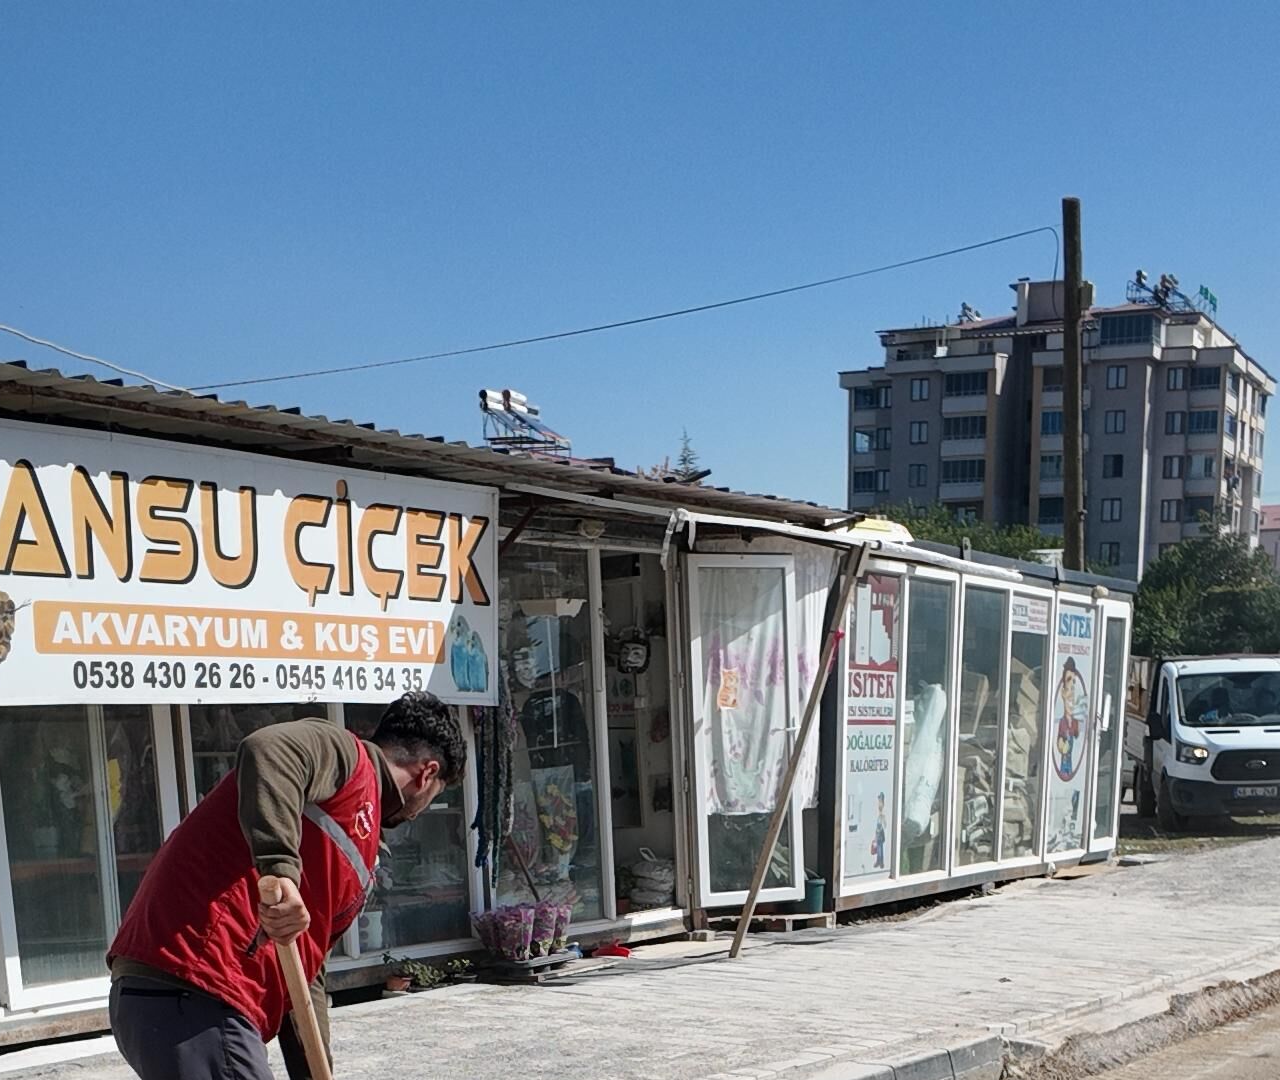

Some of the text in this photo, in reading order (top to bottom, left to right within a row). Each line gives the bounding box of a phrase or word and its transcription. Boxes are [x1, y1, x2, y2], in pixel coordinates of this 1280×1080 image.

[283, 479, 490, 611] ÇİÇEK
[52, 611, 436, 660] AKVARYUM & KUŞ EVİ
[73, 660, 135, 689] 0538
[142, 661, 186, 689] 430
[194, 662, 222, 689] 26
[229, 663, 256, 689] 26
[275, 664, 326, 690] 0545
[332, 665, 367, 691] 416
[373, 667, 396, 691] 34
[401, 668, 423, 692] 35
